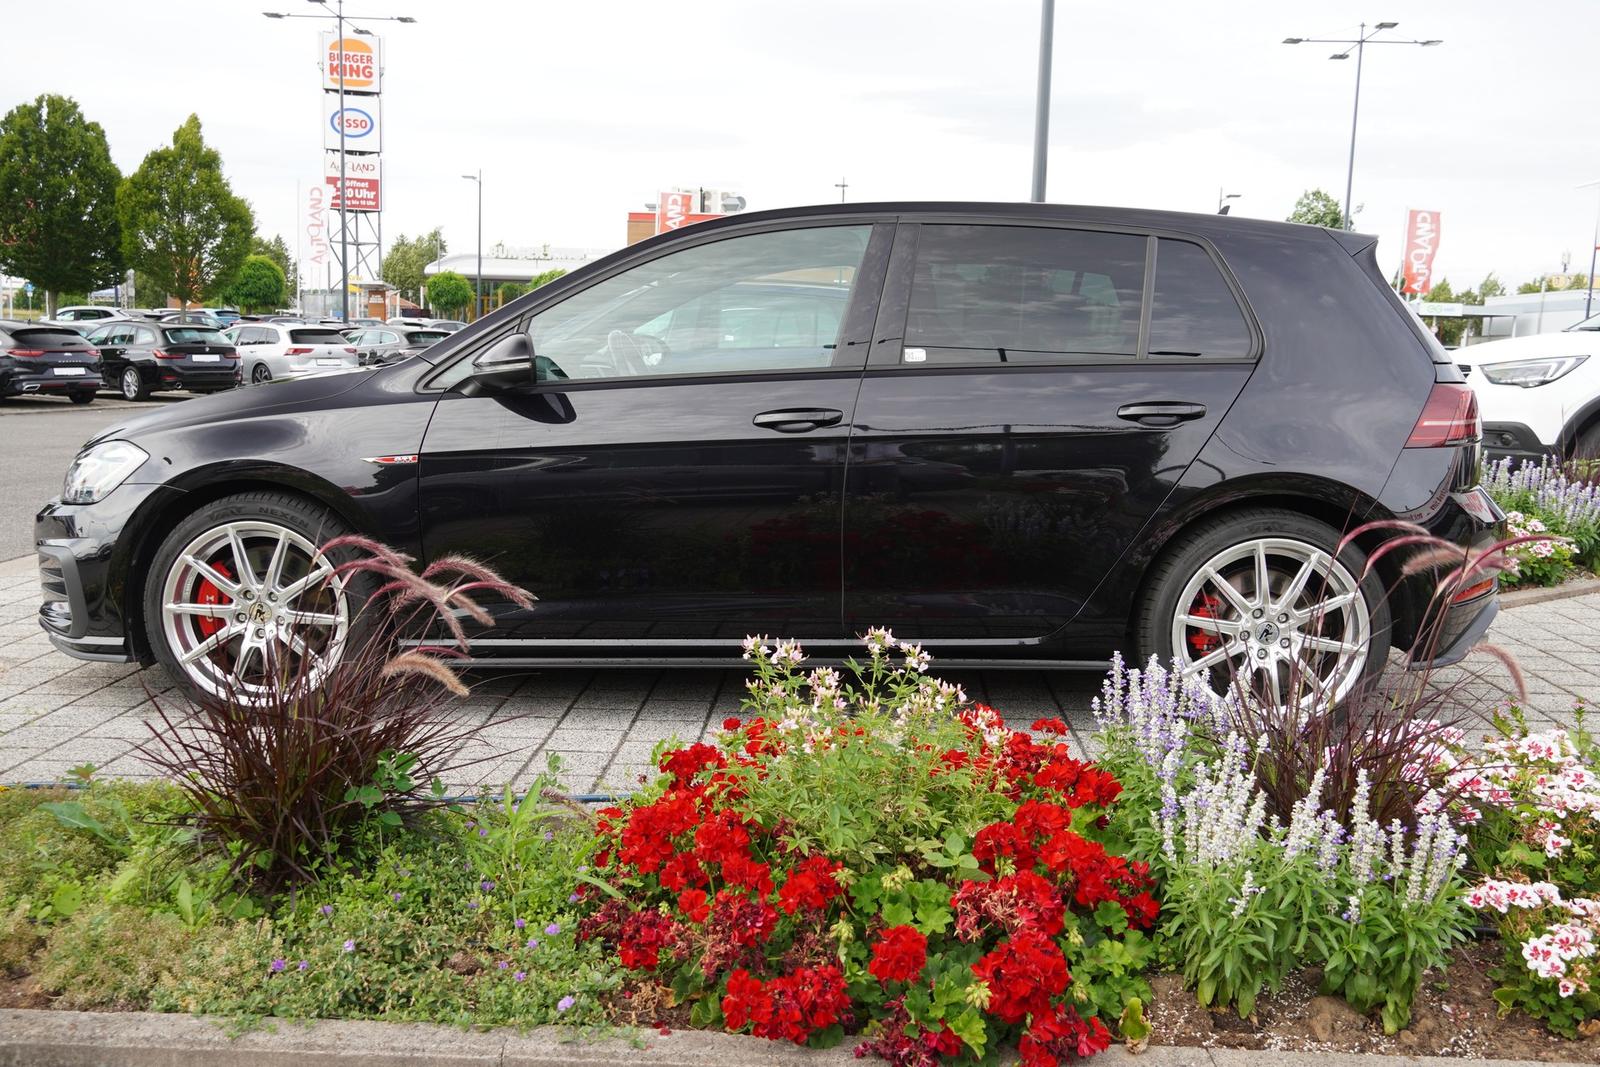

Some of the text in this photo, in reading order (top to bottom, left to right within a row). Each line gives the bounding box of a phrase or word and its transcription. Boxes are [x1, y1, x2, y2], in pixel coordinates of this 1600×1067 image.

[329, 63, 373, 79] KING
[330, 161, 376, 174] AOLAND
[336, 179, 369, 189] göffnet
[354, 189, 377, 200] Uhr
[1410, 212, 1436, 292] AUTOLAND
[258, 506, 310, 528] NEXEN
